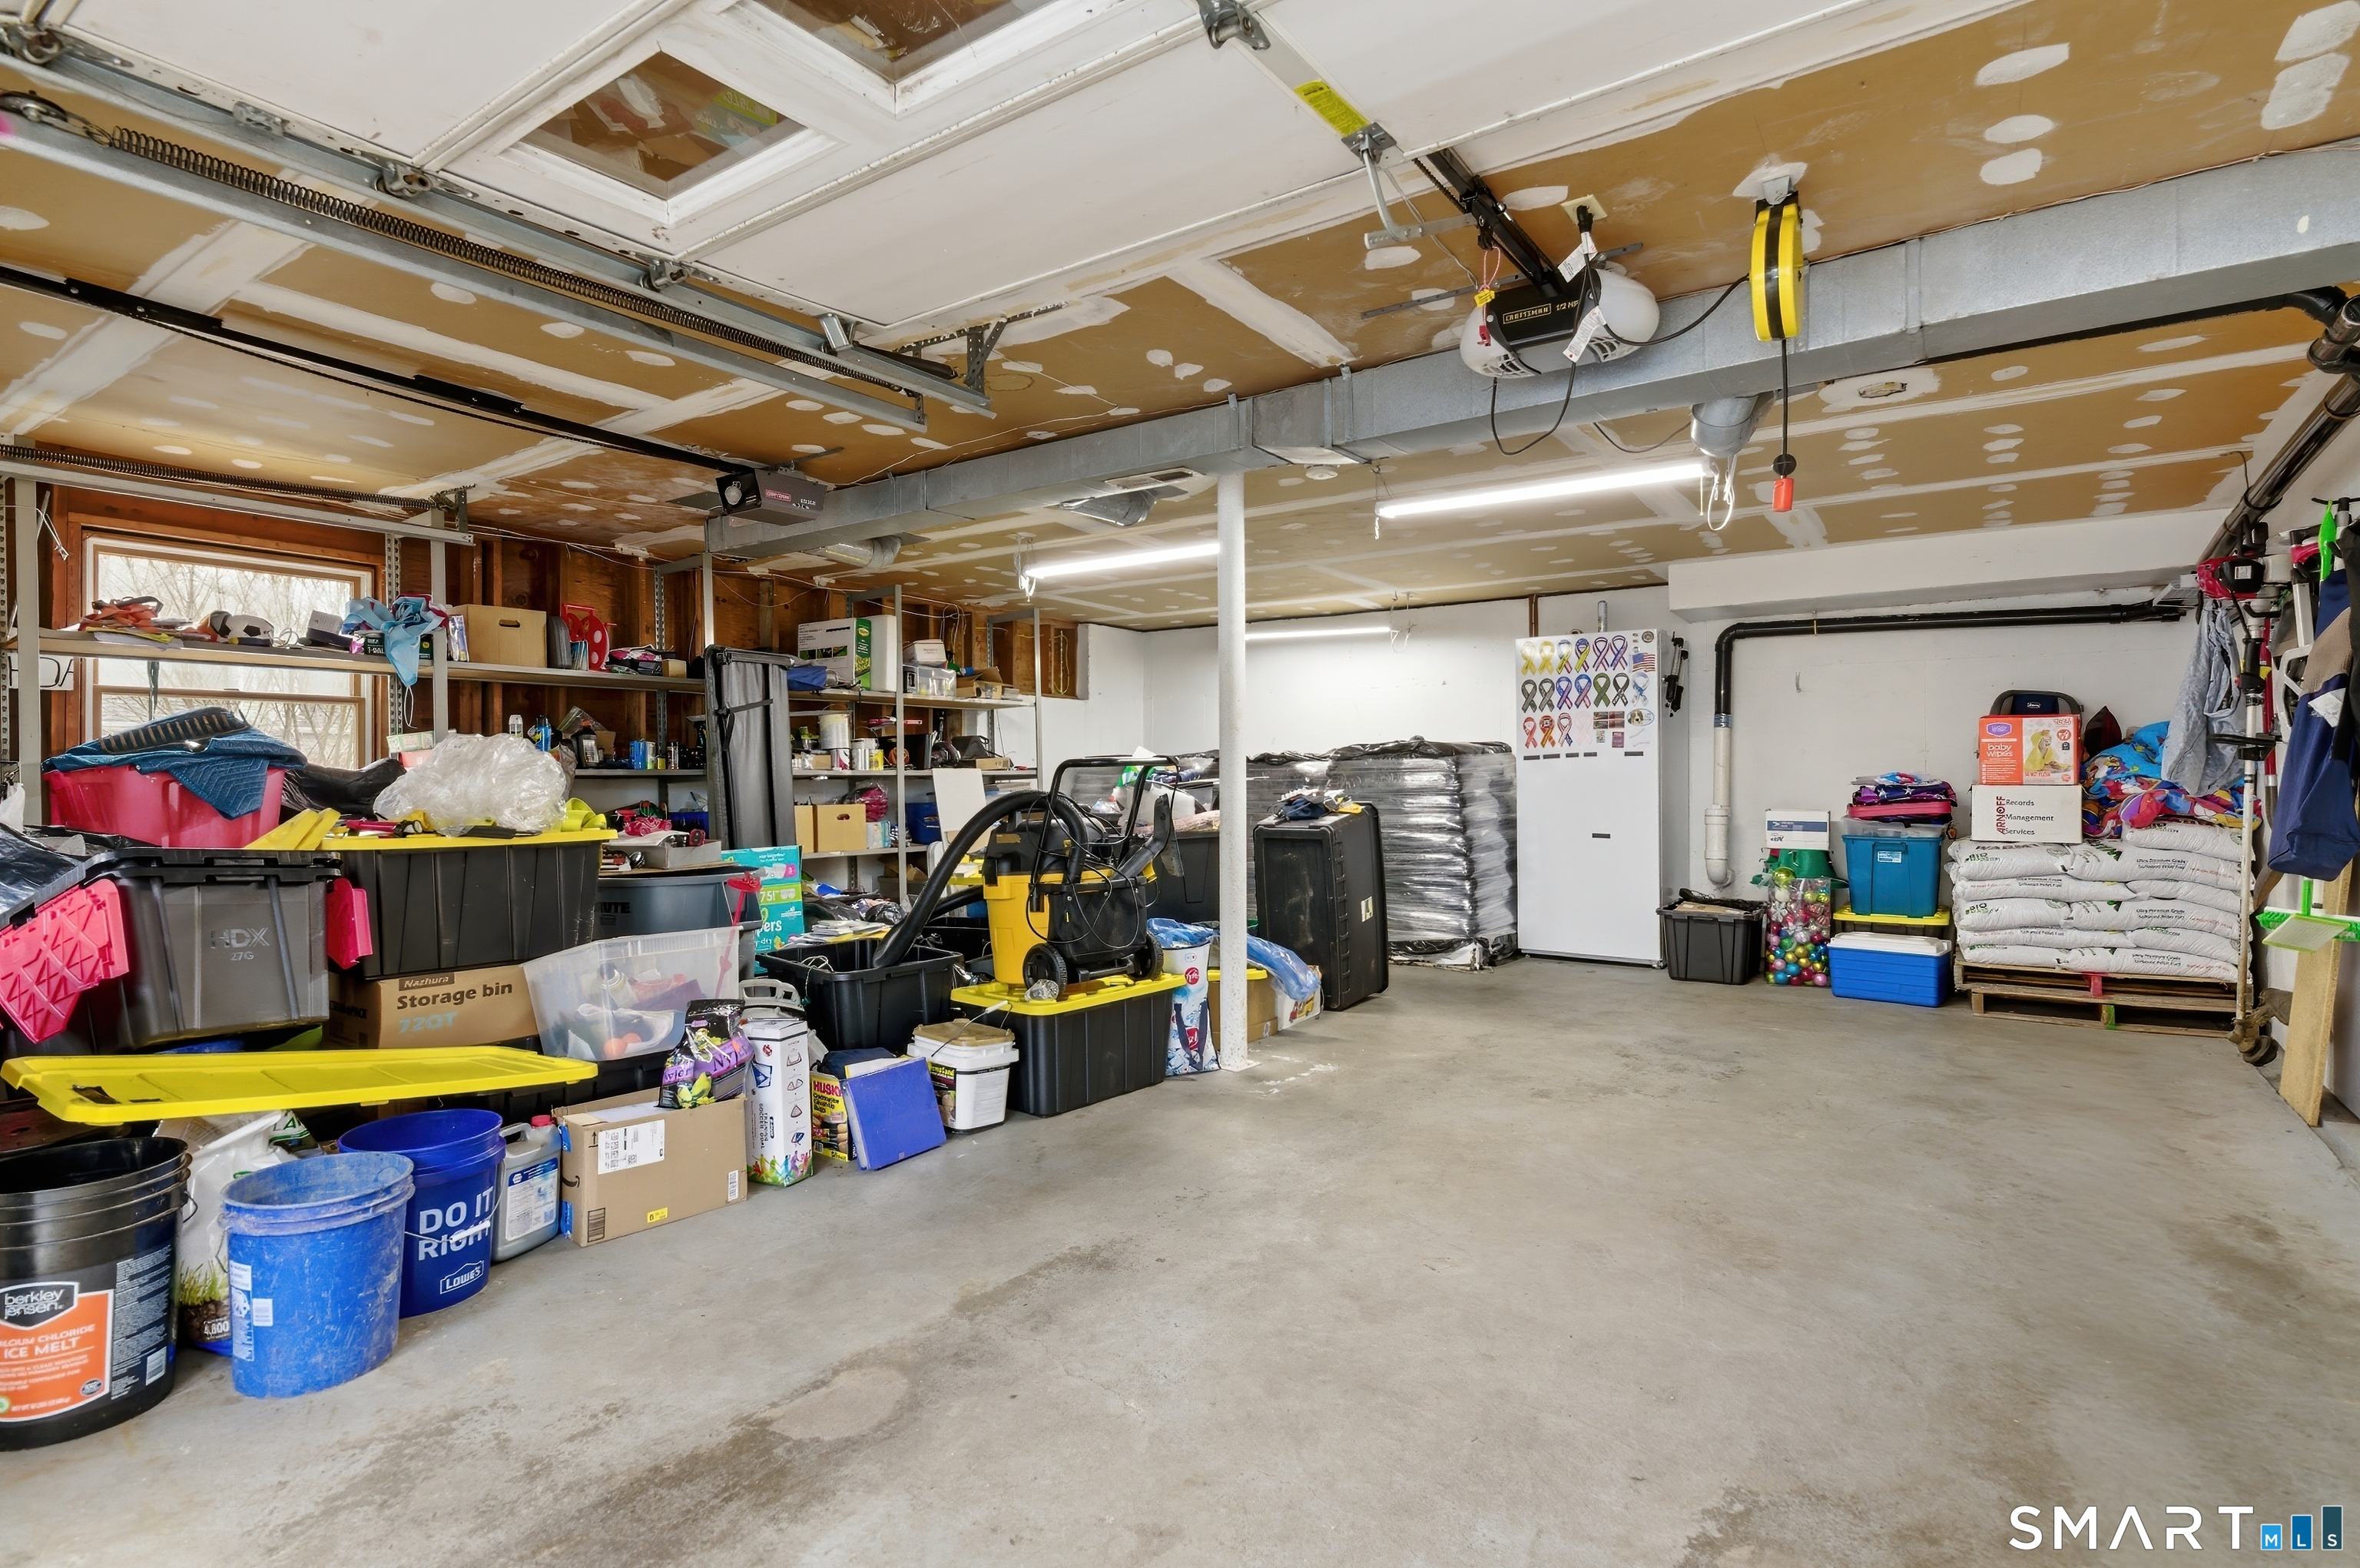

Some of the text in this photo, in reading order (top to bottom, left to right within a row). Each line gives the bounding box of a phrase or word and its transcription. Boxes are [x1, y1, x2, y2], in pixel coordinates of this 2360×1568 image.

[1987, 742, 2012, 752] baby
[1996, 795, 2006, 836] ARNOFF
[2006, 814, 2054, 822] Management
[2005, 827, 2036, 836] Services
[210, 927, 270, 950] HDX
[396, 982, 513, 1010] Storage bin
[398, 1010, 459, 1035] 72QT
[419, 1201, 467, 1235] DO
[475, 1185, 494, 1218] IT
[5, 1288, 65, 1306] berkley
[4, 1336, 81, 1360] ICE MELT
